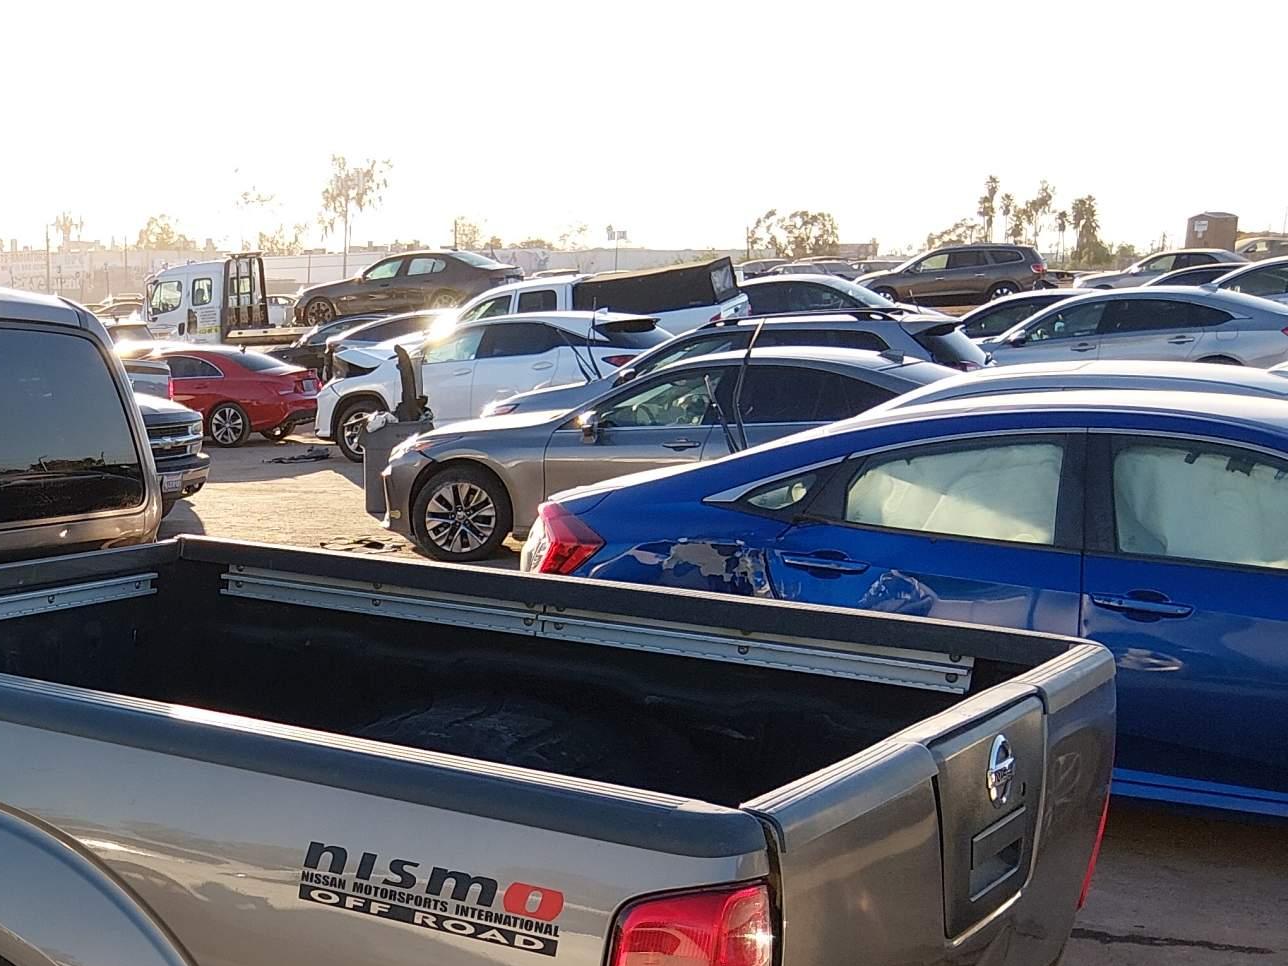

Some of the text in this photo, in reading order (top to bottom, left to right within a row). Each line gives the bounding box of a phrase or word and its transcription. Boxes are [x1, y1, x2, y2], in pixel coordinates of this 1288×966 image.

[301, 870, 560, 938] NISSAN MOTORSPORTS INTERNATIONAL
[310, 889, 545, 950] OFF ROAD
